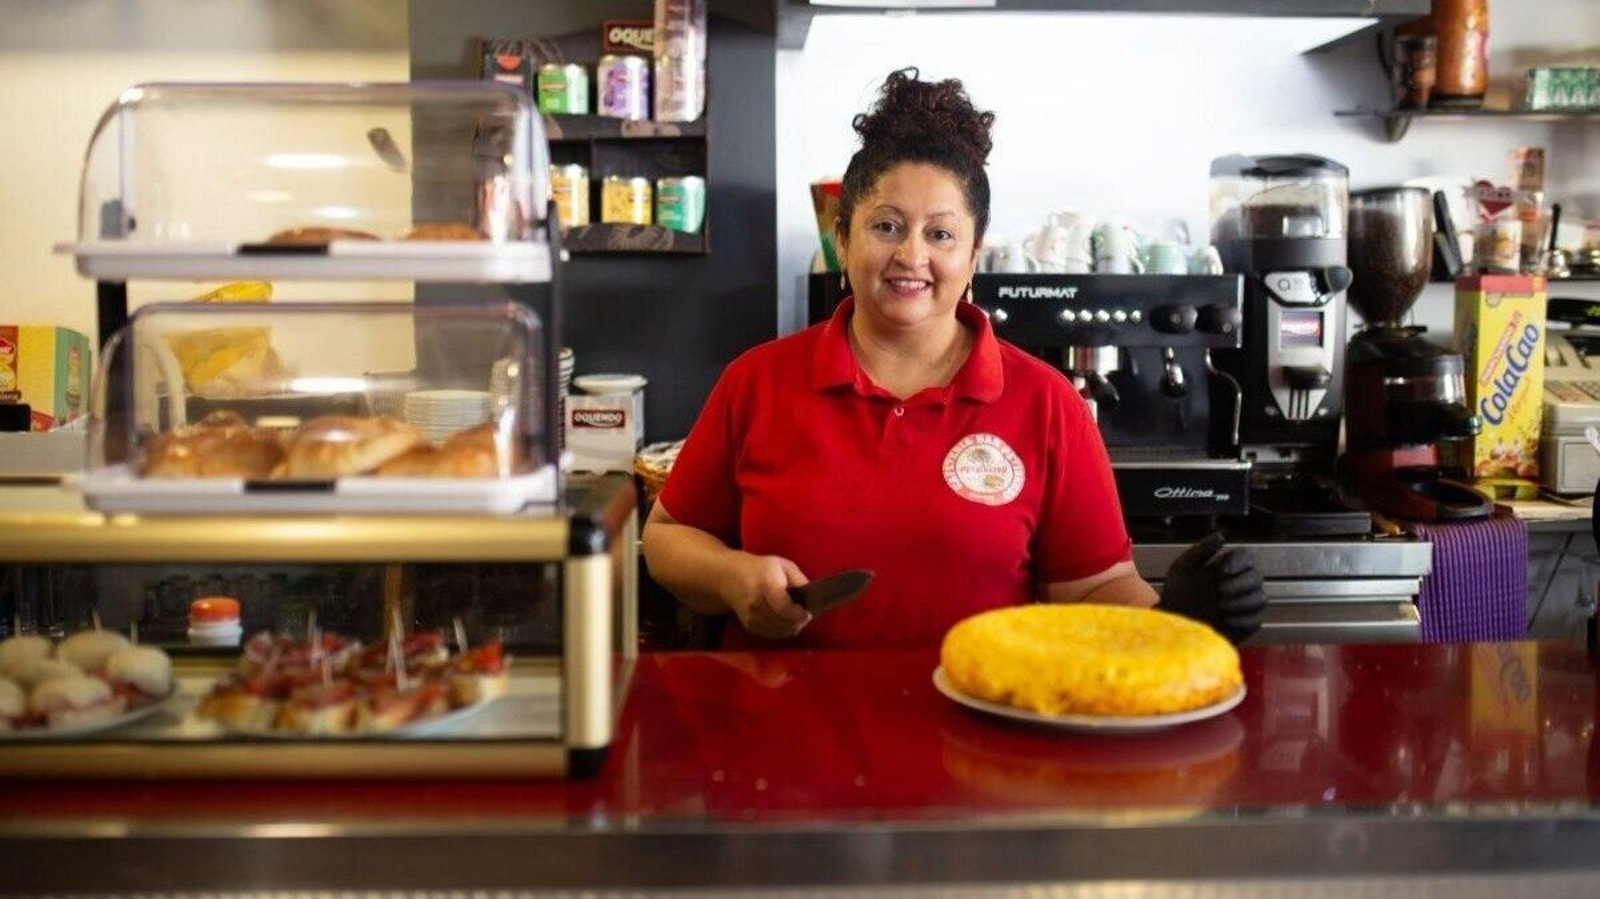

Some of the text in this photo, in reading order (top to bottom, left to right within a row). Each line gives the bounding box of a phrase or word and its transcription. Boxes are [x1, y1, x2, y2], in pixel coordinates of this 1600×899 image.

[609, 27, 654, 48] OQUE
[998, 286, 1078, 299] FUTURMAT
[1481, 324, 1539, 426] ColaCao
[574, 411, 622, 425] OQUENDO
